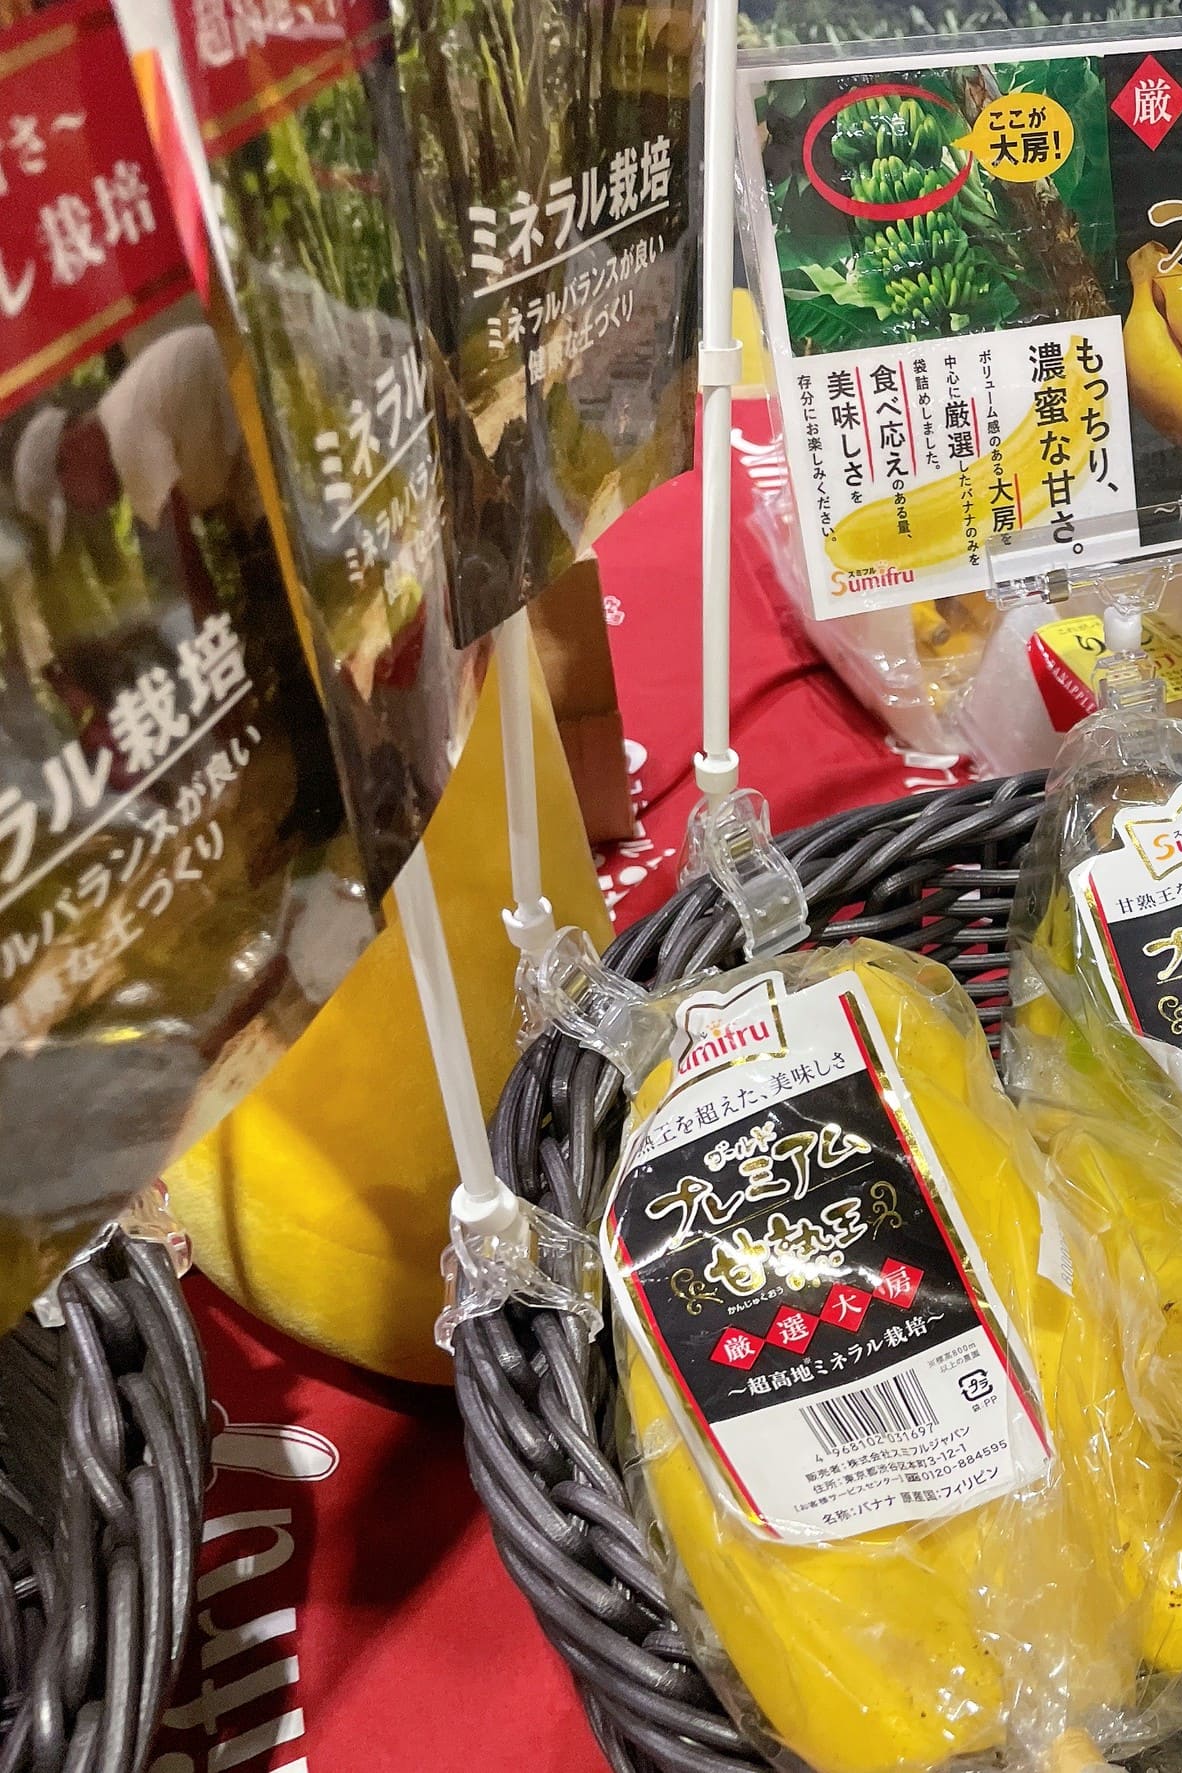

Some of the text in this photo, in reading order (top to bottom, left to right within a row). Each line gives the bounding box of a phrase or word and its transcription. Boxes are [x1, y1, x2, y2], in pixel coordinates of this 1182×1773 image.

[990, 106, 1046, 130] ここが
[990, 131, 1061, 166] 大房!
[468, 134, 672, 274] ミネラル栽培
[487, 234, 664, 350] ミネラルバランスが良い
[797, 374, 837, 543] 存分にお楽しみください。
[827, 370, 864, 504] 美味しさを
[870, 364, 913, 540] 食べ応えのある量、
[912, 359, 941, 471] 袋詰めしました。
[944, 355, 980, 567] 中心に厳選したバナナのみを
[978, 349, 1017, 546] ボリューム感のある大房を
[1028, 342, 1084, 555] 濃蜜な甘さ。
[1077, 337, 1119, 493] もっちり、
[831, 566, 915, 597] Sumifru
[679, 1020, 771, 1075] umifru
[645, 1124, 872, 1249] プレミアム
[704, 1120, 777, 1172] ゴールド
[704, 1198, 868, 1296] 甘熟王
[723, 1267, 911, 1363] 厳選大房
[815, 1422, 935, 1464] 4 968102 031697
[922, 1439, 1009, 1482] 0120-884595
[141, 1508, 309, 1773] ifru
